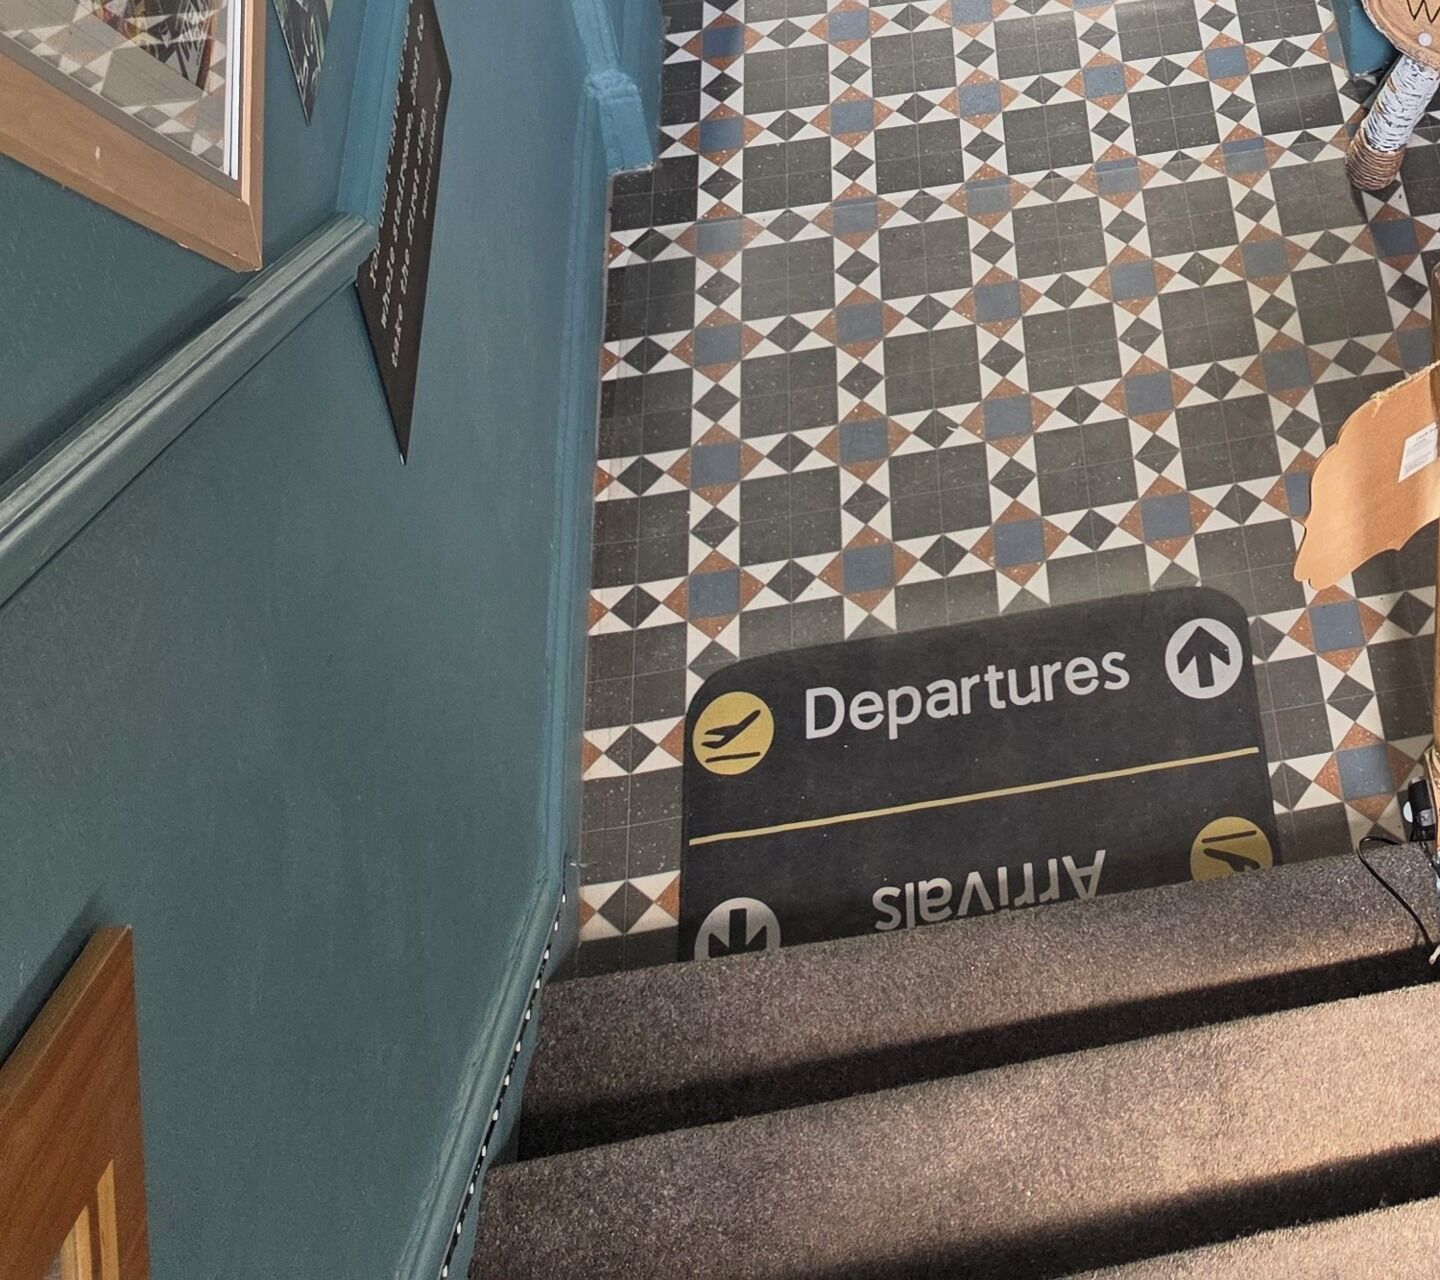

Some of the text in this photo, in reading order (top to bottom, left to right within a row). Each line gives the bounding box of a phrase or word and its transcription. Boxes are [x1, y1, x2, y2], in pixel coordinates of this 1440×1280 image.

[381, 246, 395, 329] whole
[410, 46, 420, 106] just
[417, 13, 424, 41] to
[392, 108, 427, 368] take the first step
[803, 648, 1131, 742] Departures
[872, 847, 1107, 932] Arrivals
